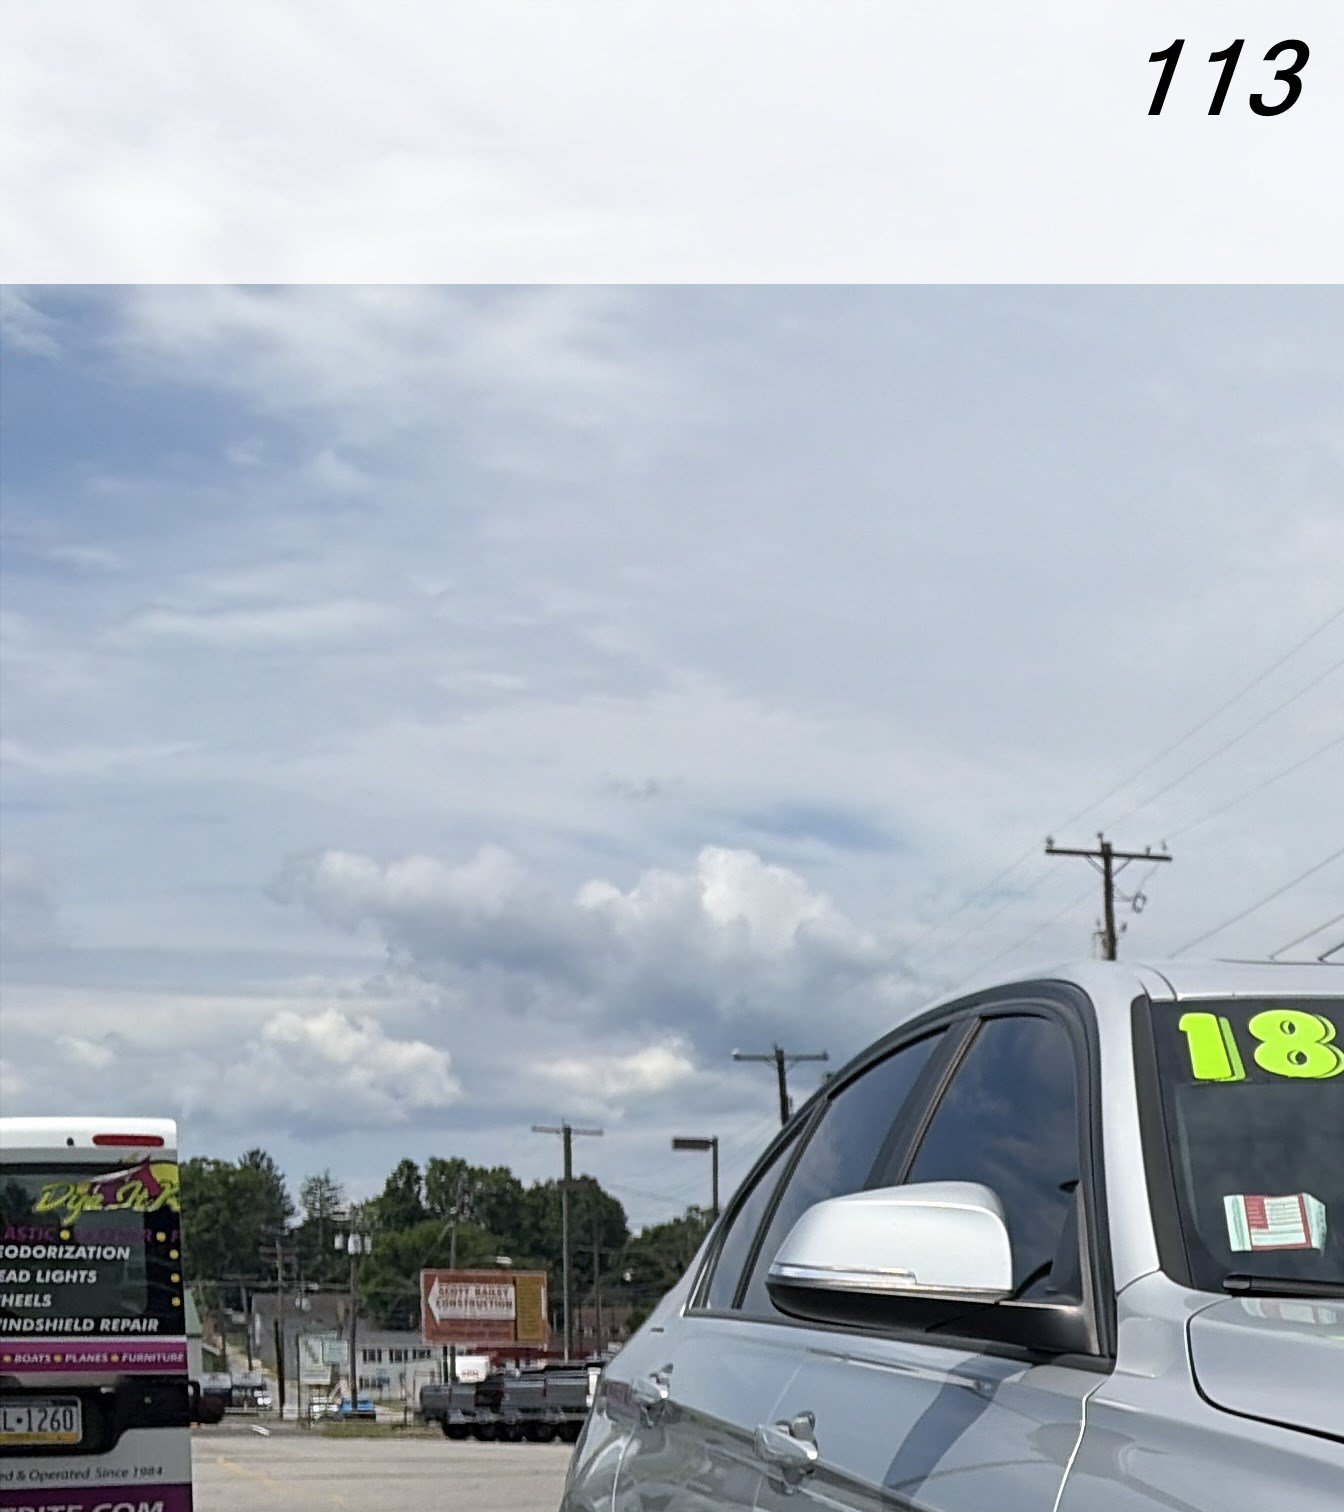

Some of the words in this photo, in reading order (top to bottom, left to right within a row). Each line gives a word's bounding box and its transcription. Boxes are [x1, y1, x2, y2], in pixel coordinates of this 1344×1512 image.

[36, 1269, 98, 1284] LIGHTS
[0, 1293, 52, 1309] HEELS
[0, 1317, 95, 1333] INDSHIELD
[100, 1317, 159, 1333] REPAIR
[14, 1354, 52, 1364] BOATS
[65, 1354, 109, 1364] PLANES
[121, 1353, 184, 1364] FURNITURE
[29, 1467, 91, 1483] Operated
[95, 1466, 130, 1479] Since
